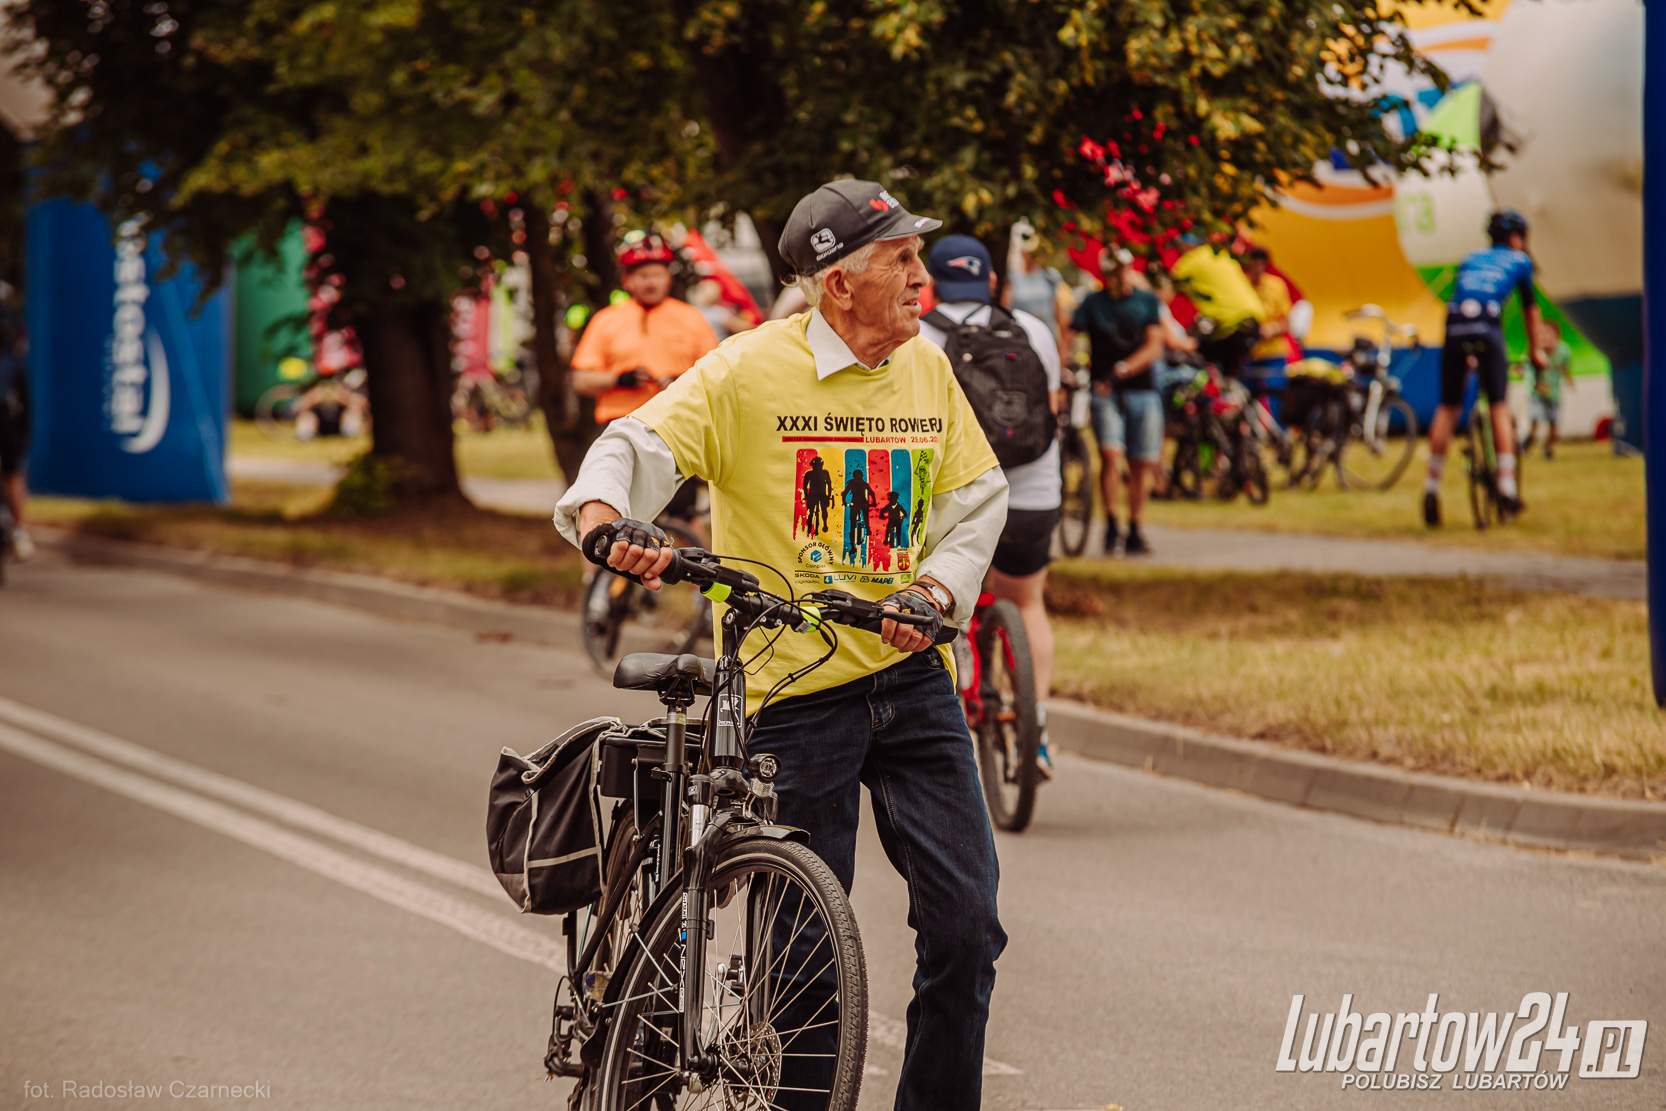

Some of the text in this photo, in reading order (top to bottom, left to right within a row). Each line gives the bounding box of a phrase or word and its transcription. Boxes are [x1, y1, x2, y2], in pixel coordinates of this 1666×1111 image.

[776, 416, 817, 432] XXXI
[824, 412, 885, 436] ŚWIĘTO
[797, 541, 817, 564] SPONSOR
